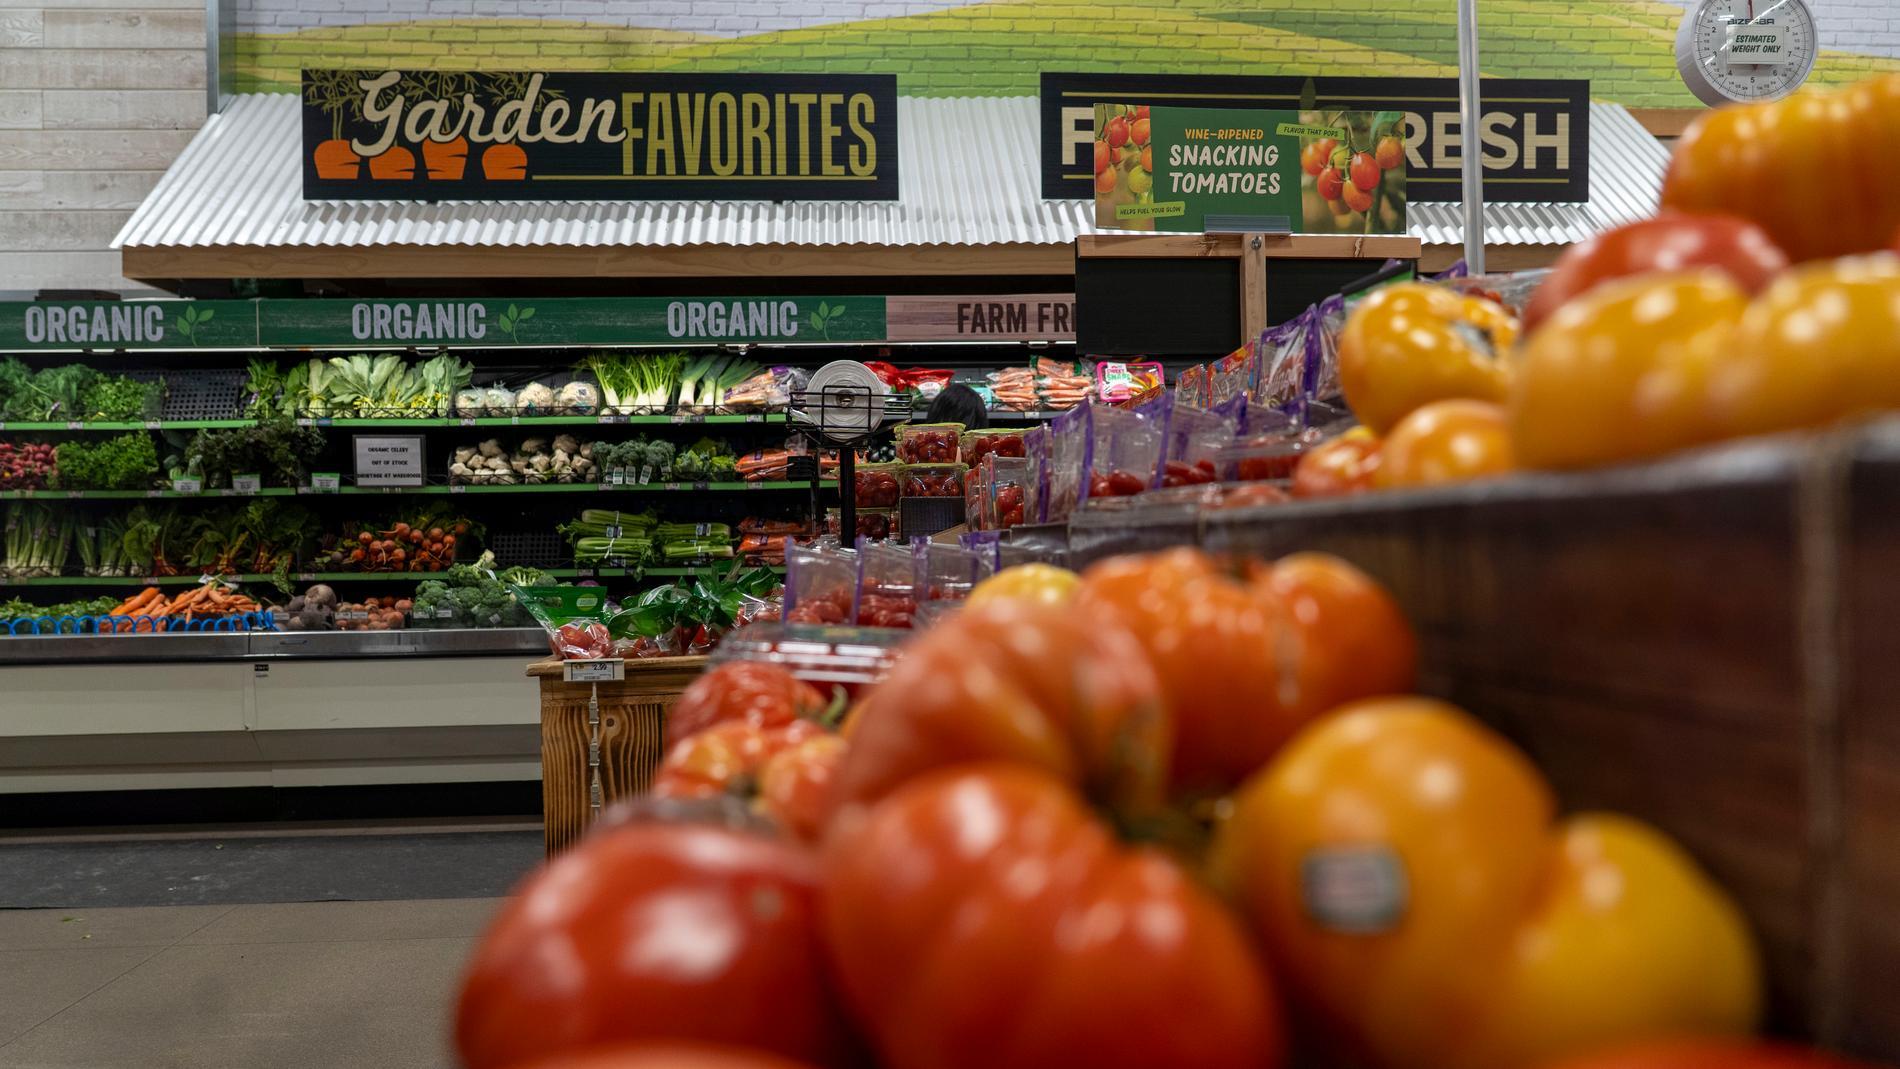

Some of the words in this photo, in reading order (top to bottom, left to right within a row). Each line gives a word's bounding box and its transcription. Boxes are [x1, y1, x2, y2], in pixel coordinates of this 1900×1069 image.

[1731, 45, 1761, 53] WEIGHT
[1762, 45, 1781, 53] ONLY
[1735, 35, 1777, 43] ESTIMATED
[351, 70, 627, 157] Garden
[621, 91, 877, 177] FAVORITES
[1184, 128, 1264, 140] VINE-RIPENED
[1283, 126, 1307, 134] FLAVOR
[1307, 128, 1322, 136] THAT
[1323, 129, 1339, 137] POPS
[1404, 111, 1570, 170] RESH
[1169, 144, 1279, 166] SNACKING
[1169, 172, 1281, 195] TOMATOES
[25, 305, 164, 343] ORGANIC
[352, 303, 486, 340] ORGANIC
[667, 301, 798, 337] ORGANIC
[957, 303, 1027, 333] FARM
